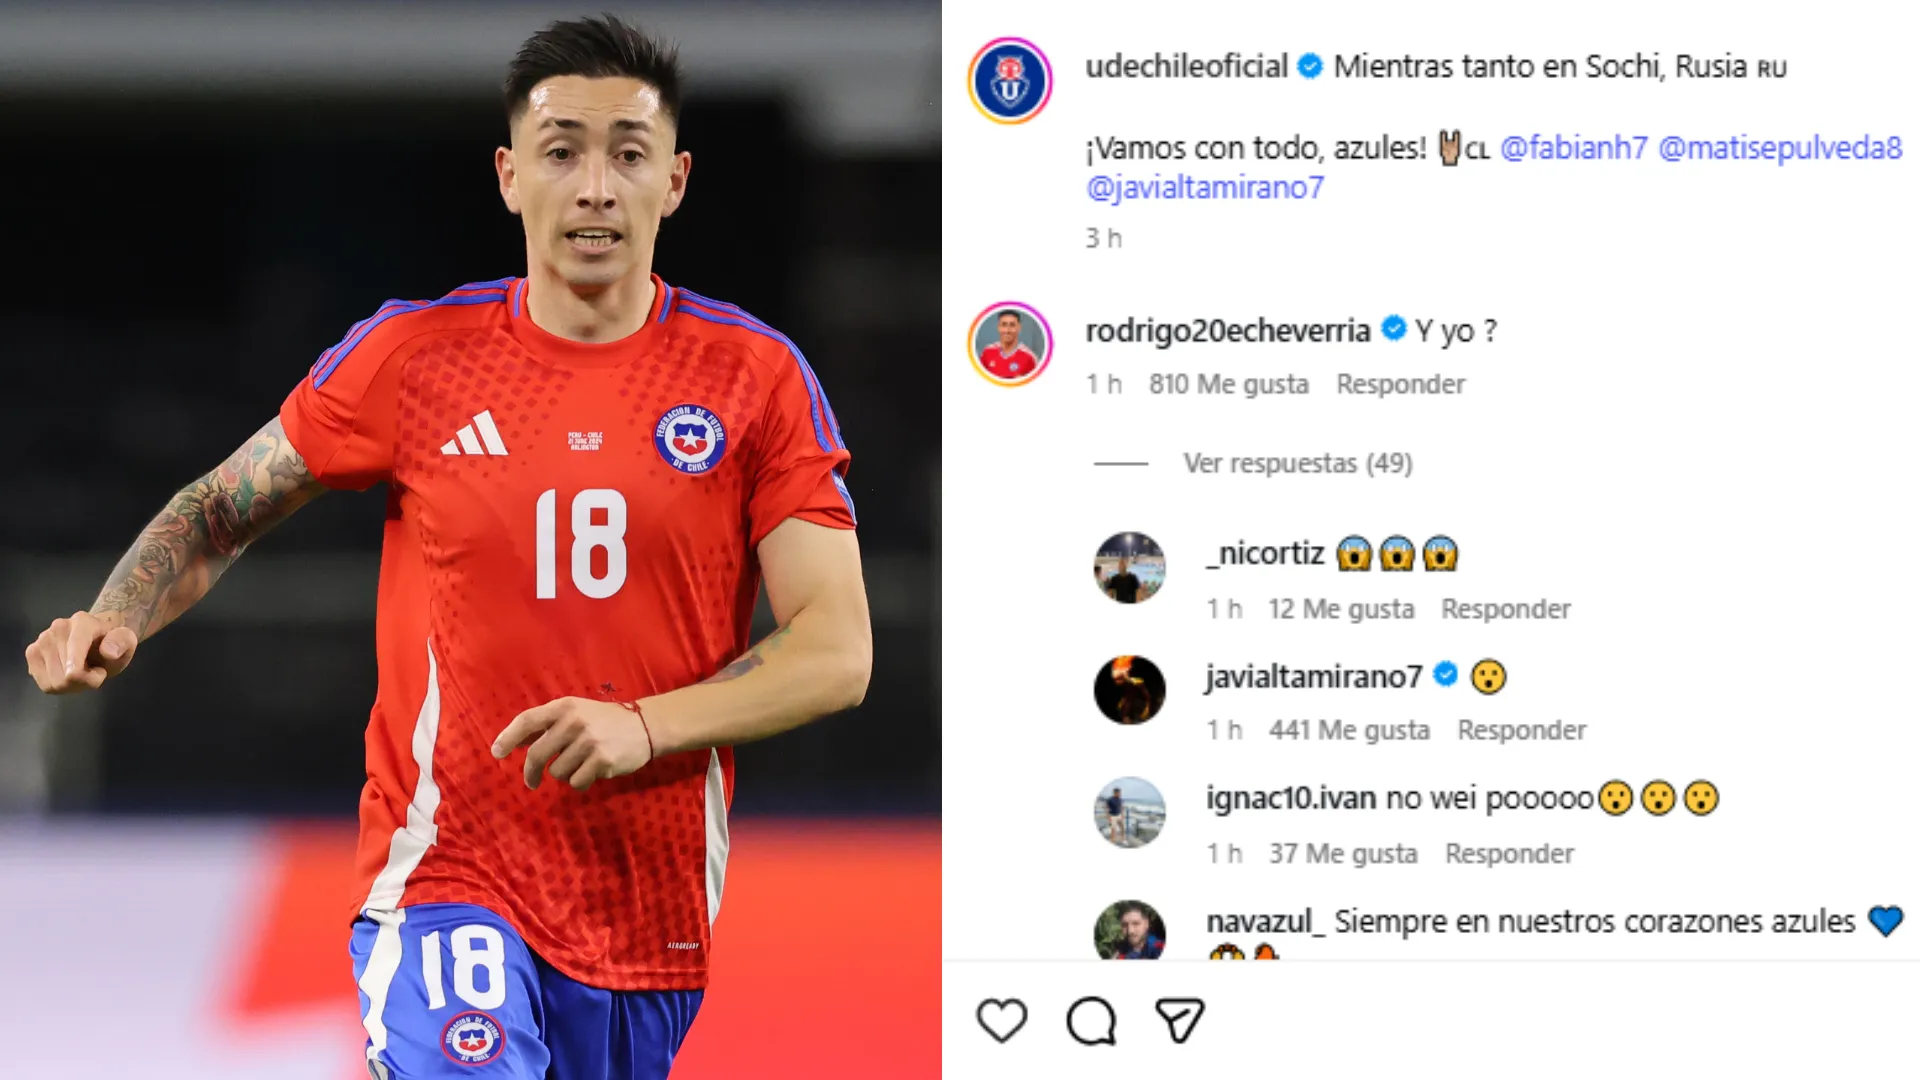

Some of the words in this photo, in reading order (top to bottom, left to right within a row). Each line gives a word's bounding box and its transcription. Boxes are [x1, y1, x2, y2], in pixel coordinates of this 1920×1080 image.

[1086, 52, 1288, 78] udechileoficial
[1335, 52, 1453, 78] Mientras
[1462, 54, 1535, 78] tanto
[1543, 59, 1577, 78] en
[1586, 52, 1665, 82] Sochi,
[1677, 52, 1747, 78] Rusia
[1758, 60, 1787, 78] RU
[1087, 136, 1186, 167] ¡Vamos
[1195, 141, 1245, 159] con
[1252, 134, 1324, 164] todo,
[1334, 134, 1426, 160] azules!
[1501, 133, 1648, 162] @fabianh7
[1659, 134, 1903, 166] @matisepulveda8
[1088, 173, 1324, 206] @javialtamirano7
[1087, 228, 1099, 248] 3
[1109, 228, 1121, 247] h
[1087, 316, 1371, 350] rodrigo20echeverria
[1415, 319, 1434, 342] Y
[1441, 324, 1475, 350] yo
[1485, 319, 1497, 342] ?
[1088, 374, 1096, 393] 1
[1109, 374, 1121, 393] h
[1150, 373, 1188, 394] 810
[1198, 373, 1235, 394] Me
[1244, 374, 1309, 399] gusta
[1338, 373, 1466, 398] Responder
[656, 406, 691, 437] FEDERACION
[695, 407, 706, 418] DE
[707, 415, 724, 442] FUTBOL
[673, 458, 684, 469] DE
[687, 461, 708, 472] CHILE
[1184, 453, 1223, 473] Ver
[1232, 453, 1357, 478] respuestas
[1367, 453, 1412, 478] (49)
[536, 488, 627, 599] 18
[1205, 539, 1325, 570] _nicortiz
[1208, 599, 1216, 618] 1
[1229, 599, 1241, 618] h
[1270, 598, 1294, 619] 12
[1304, 598, 1340, 619] Me
[1349, 599, 1414, 624] gusta
[1443, 598, 1571, 623] Responder
[1202, 662, 1423, 696] javialtamirano7
[1208, 720, 1216, 739] 1
[1229, 720, 1241, 739] h
[1269, 720, 1309, 740] 441
[1319, 720, 1356, 740] Me
[1365, 720, 1430, 745] gusta
[1459, 719, 1587, 744] Responder
[1207, 784, 1377, 817] ignac10.ivan
[1387, 791, 1422, 809] no
[1430, 783, 1476, 809] wei
[1487, 790, 1595, 817] pooooo
[1208, 843, 1216, 863] 1
[1229, 844, 1241, 863] h
[1271, 843, 1298, 863] 37
[1307, 843, 1344, 863] Me
[1353, 843, 1417, 868] gusta
[1447, 843, 1575, 868] Responder
[1207, 907, 1326, 938] navazul_
[1336, 907, 1448, 940] Siempre
[1456, 914, 1489, 933] en
[1499, 909, 1616, 933] nuestros
[1625, 914, 1763, 933] corazones
[1771, 907, 1856, 933] azules
[421, 924, 506, 1010] 18
